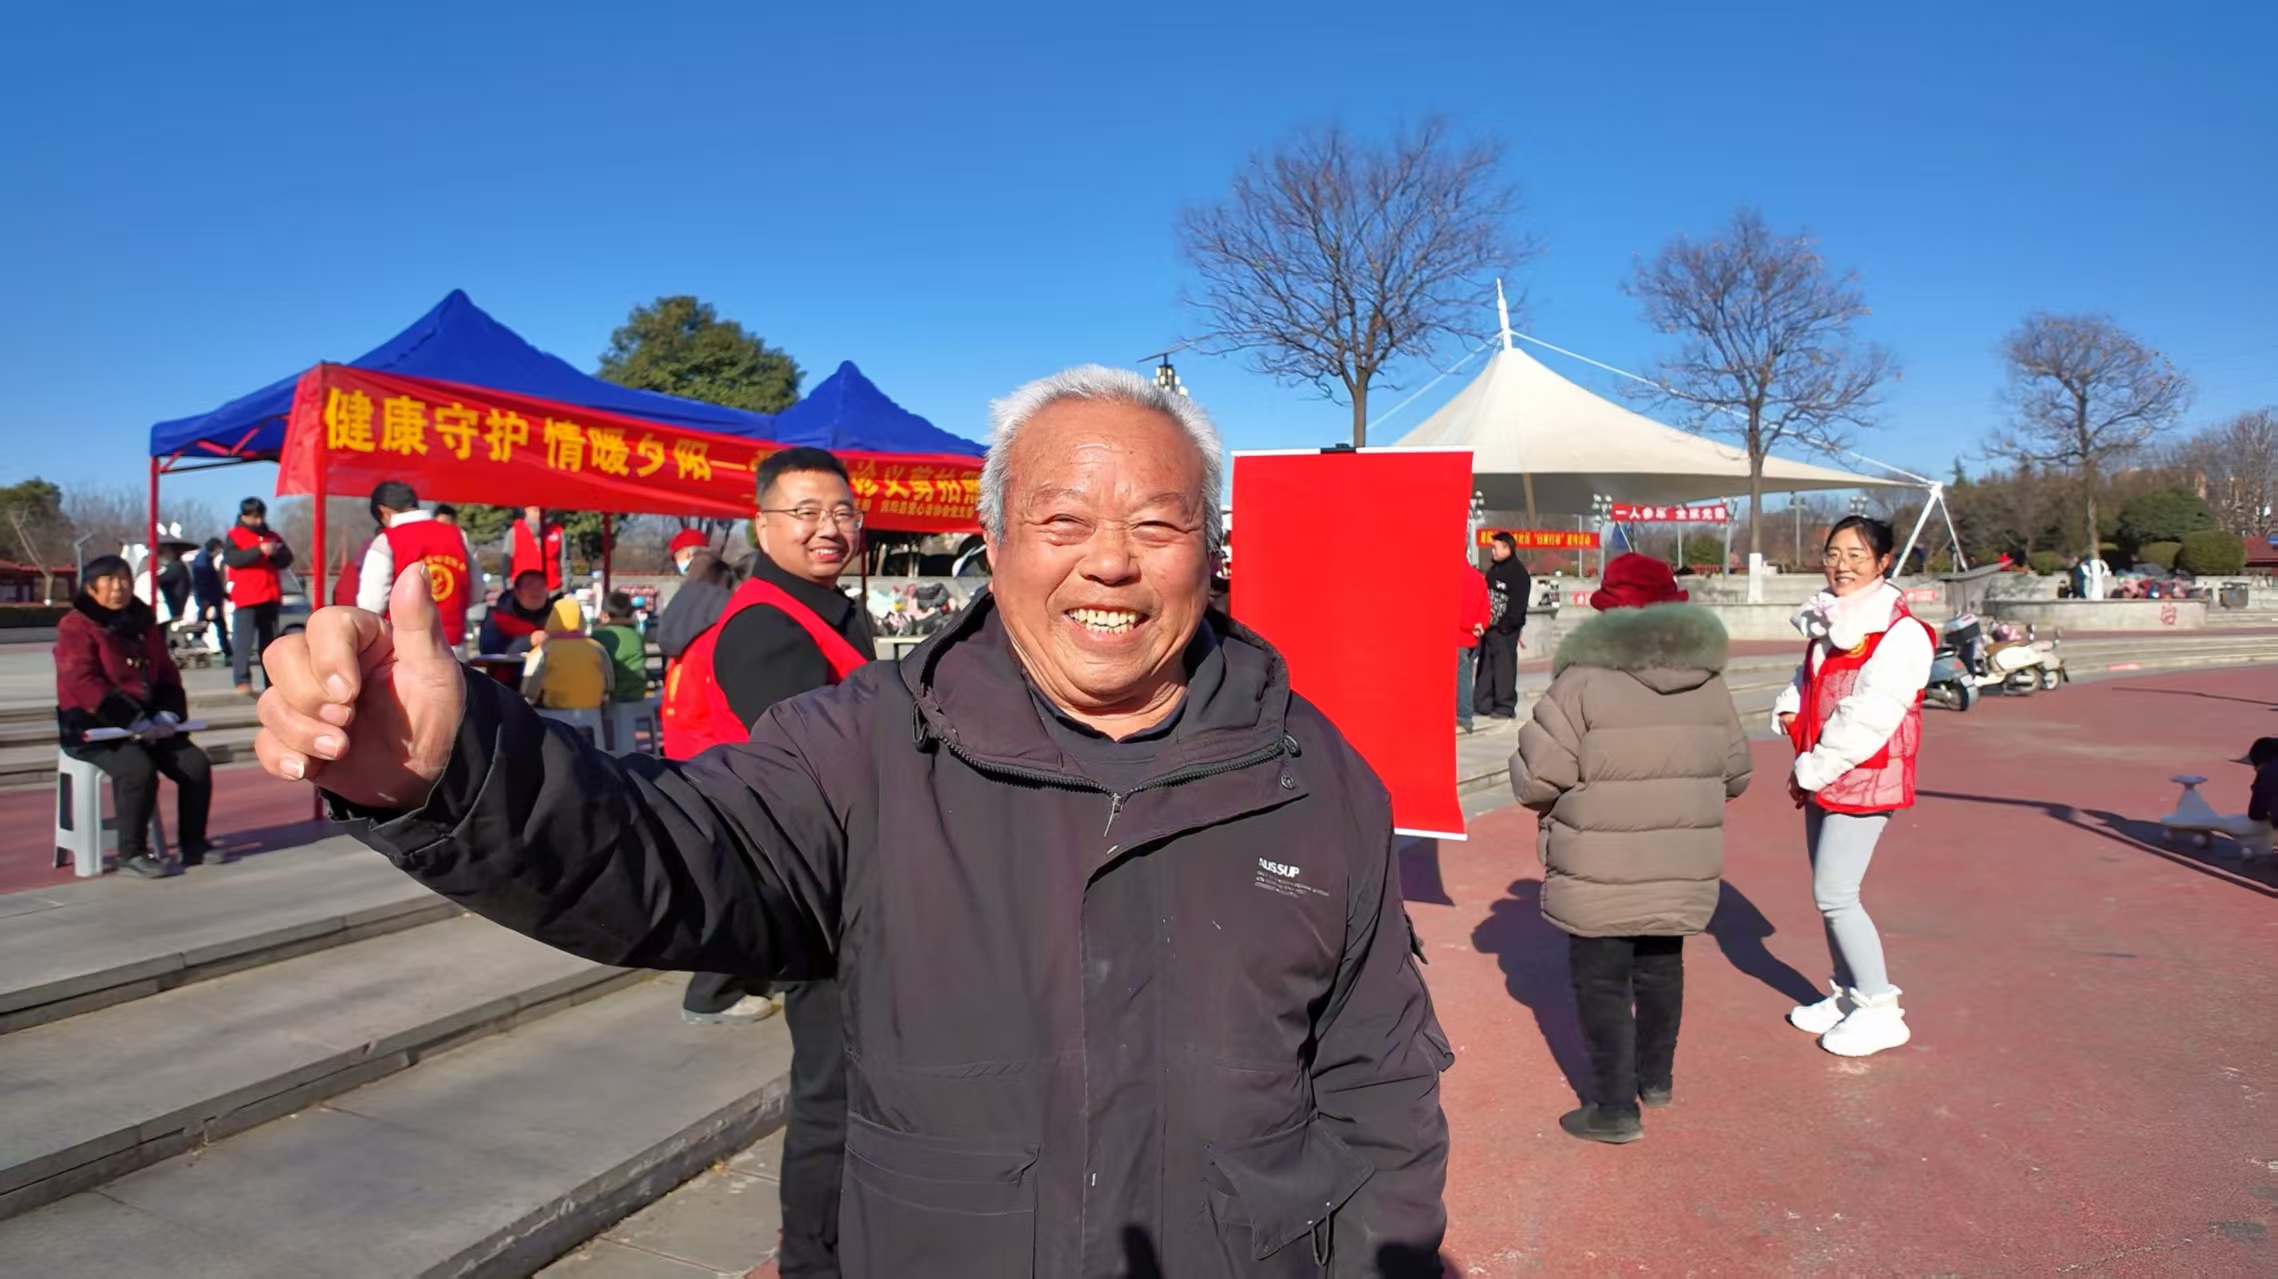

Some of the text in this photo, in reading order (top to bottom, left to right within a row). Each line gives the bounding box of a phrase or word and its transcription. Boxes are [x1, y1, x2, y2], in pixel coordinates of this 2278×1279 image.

[324, 386, 981, 504] 健康守护 情暖夕阳— 诊义剪拍照
